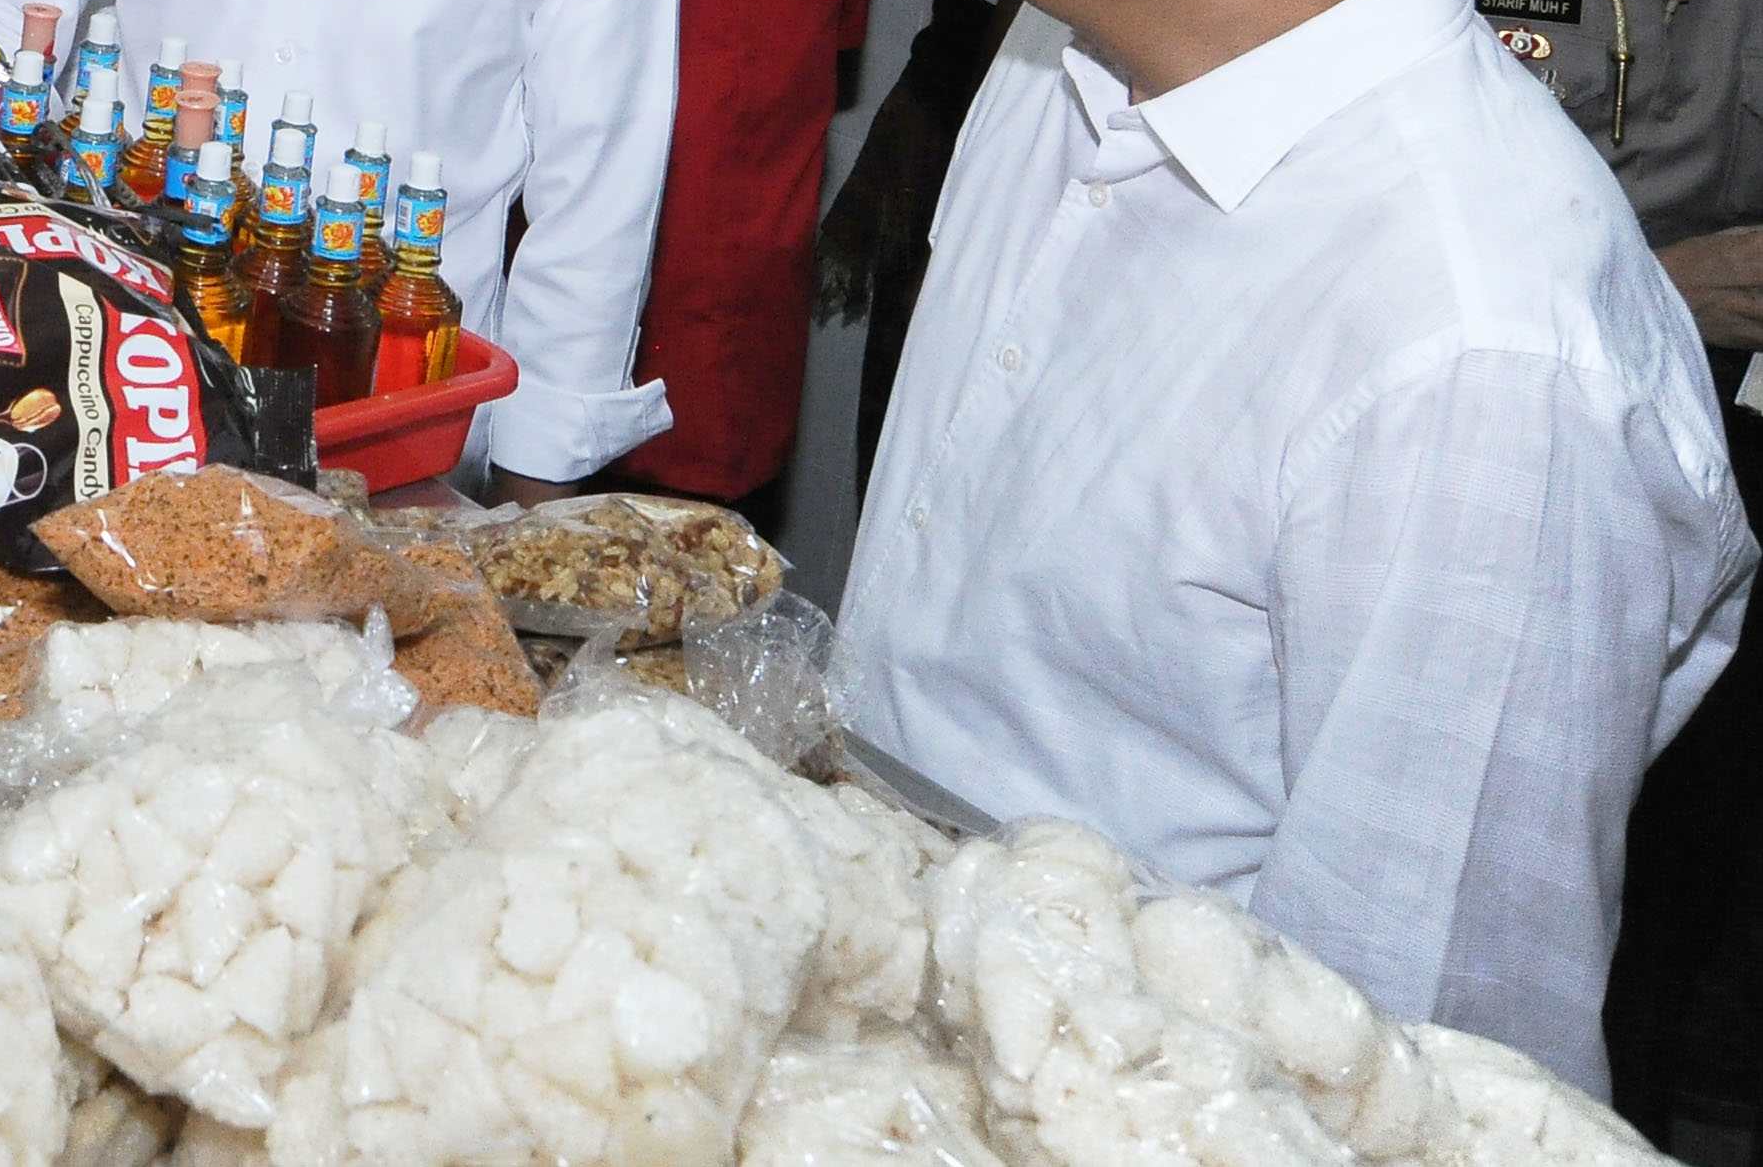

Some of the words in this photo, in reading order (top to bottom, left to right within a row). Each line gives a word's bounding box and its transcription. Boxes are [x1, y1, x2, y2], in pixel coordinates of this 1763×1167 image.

[1562, 2, 1571, 15] F
[74, 303, 101, 421] Cappuccino
[80, 427, 104, 498] Candy
